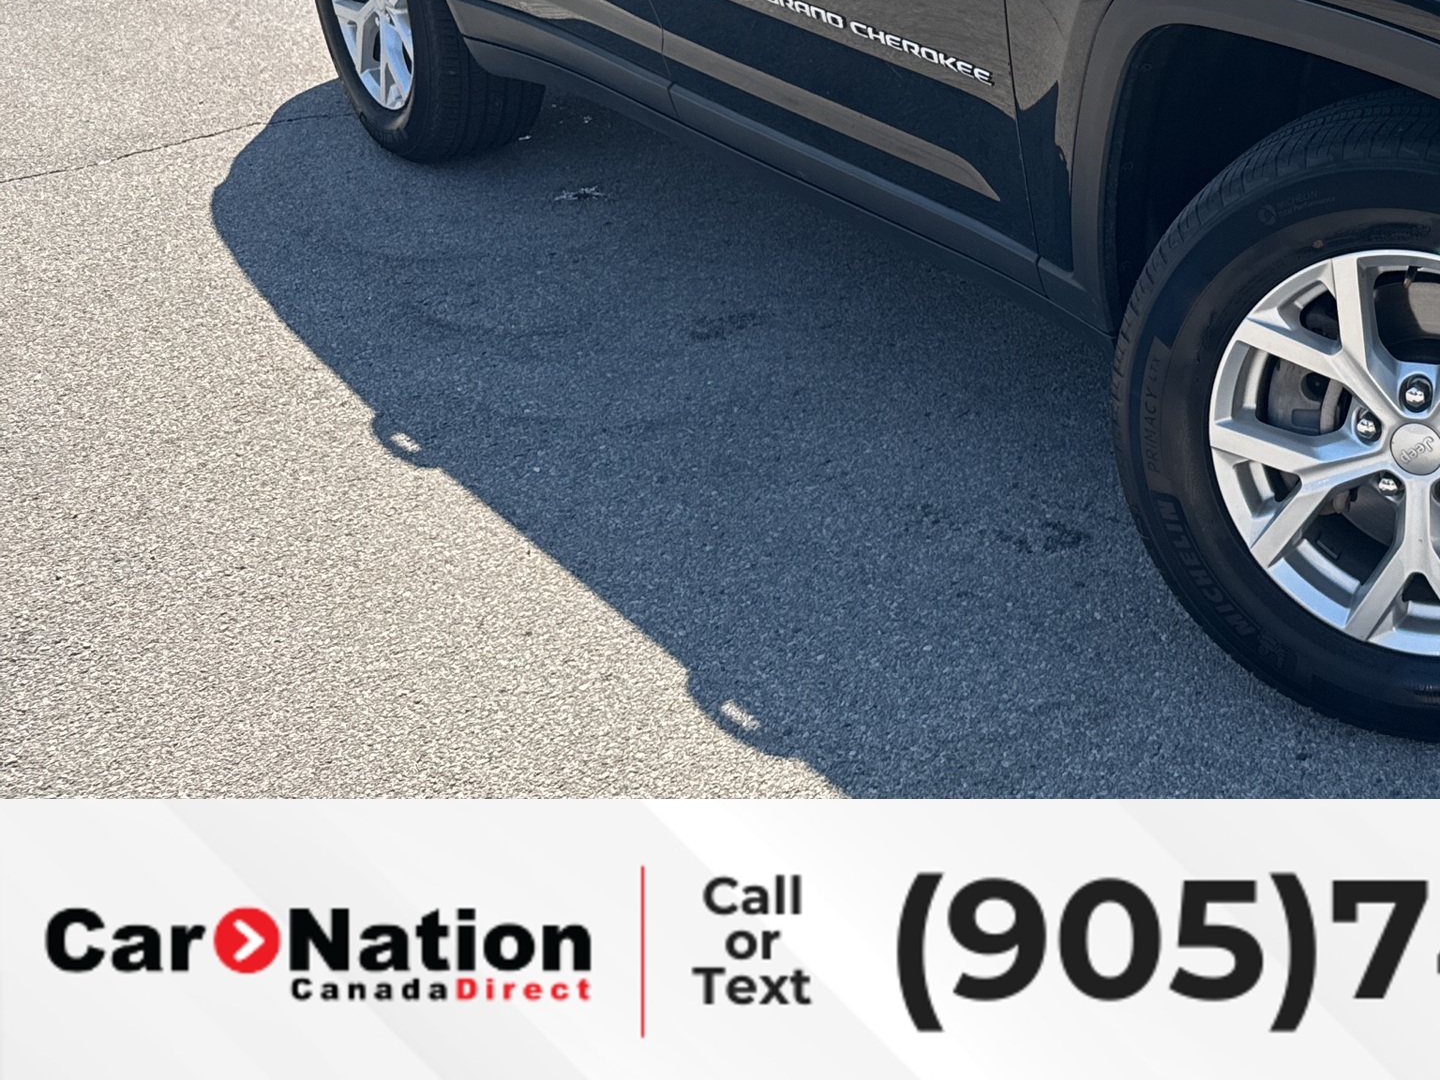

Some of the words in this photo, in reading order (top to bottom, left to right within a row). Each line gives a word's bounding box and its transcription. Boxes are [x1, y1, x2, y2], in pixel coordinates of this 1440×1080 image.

[849, 21, 995, 87] CHEROKEE
[1399, 435, 1436, 464] Jeep
[1156, 497, 1256, 637] MICHELIN
